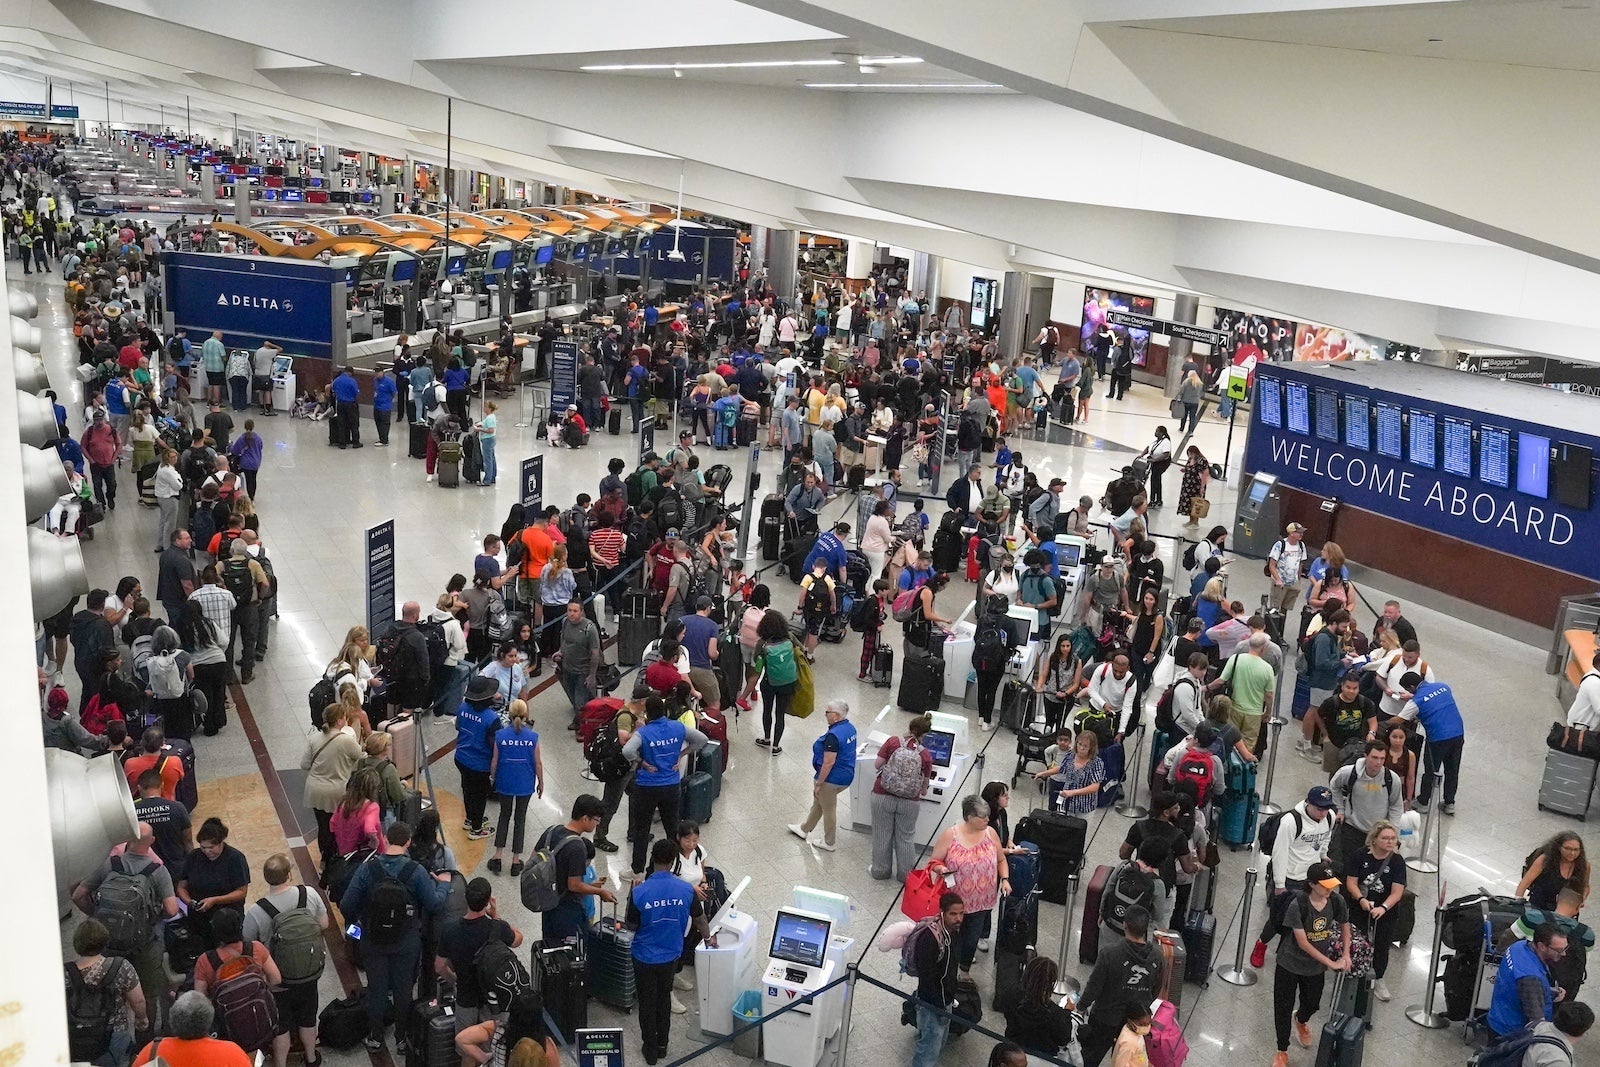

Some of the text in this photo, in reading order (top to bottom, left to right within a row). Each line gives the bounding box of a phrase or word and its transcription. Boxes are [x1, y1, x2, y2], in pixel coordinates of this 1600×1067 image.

[343, 179, 349, 187] 2
[226, 186, 231, 196] 1
[250, 262, 256, 271] 3
[232, 295, 279, 310] DELTA
[1131, 317, 1154, 327] Checkpoint
[1172, 325, 1185, 333] South
[1185, 328, 1210, 338] Checkpoint
[1222, 316, 1287, 342] SHOP
[1272, 435, 1415, 502] WELCOME
[1423, 480, 1574, 546] ABOARD
[1428, 687, 1447, 698] DELTA
[465, 712, 482, 724] DELTA
[656, 737, 678, 746] DELTA
[136, 805, 170, 814] BROOKS
[653, 898, 684, 908] DELTA
